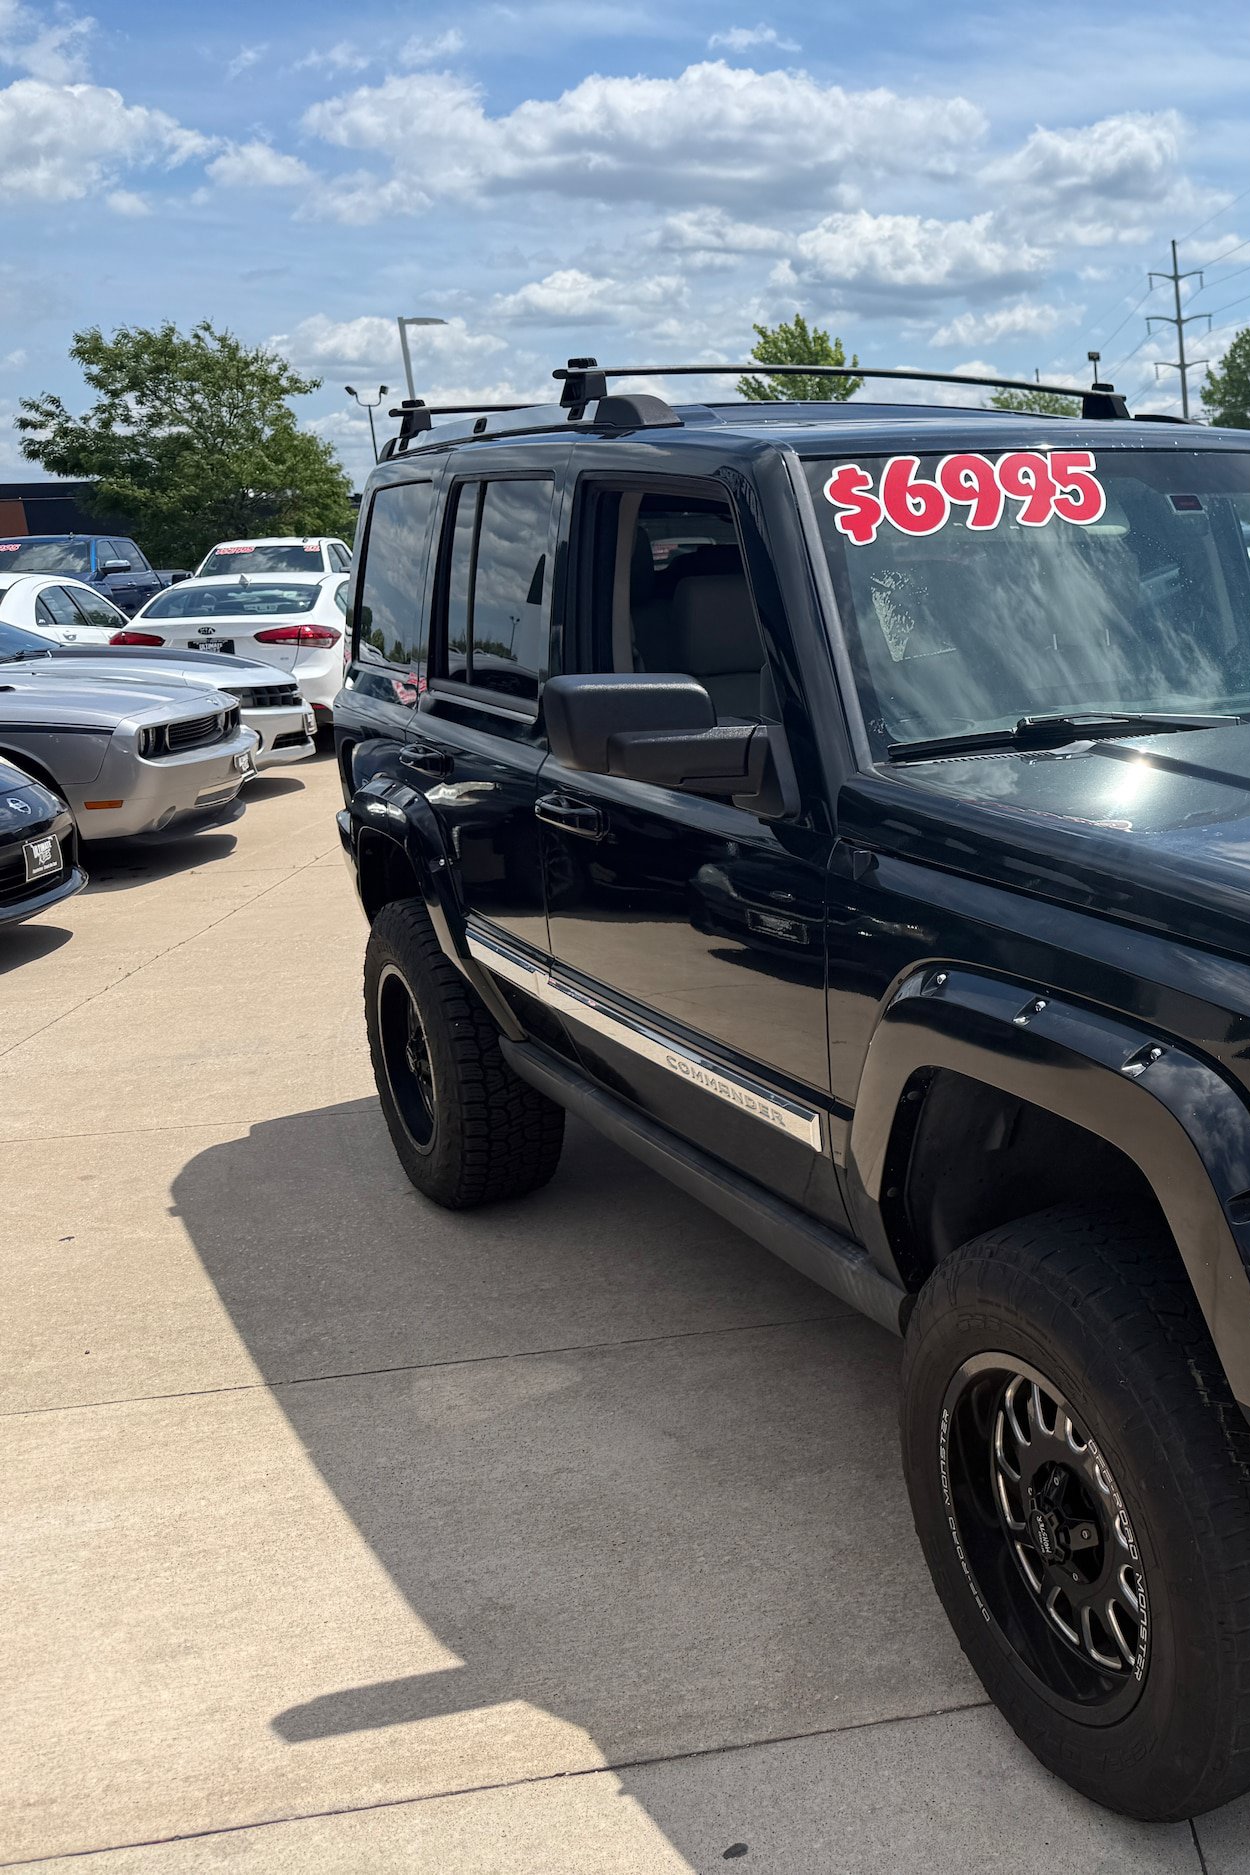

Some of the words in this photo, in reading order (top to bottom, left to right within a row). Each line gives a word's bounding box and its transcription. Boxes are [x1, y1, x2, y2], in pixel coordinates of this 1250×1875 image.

[825, 452, 1105, 545] $6995
[665, 1054, 787, 1127] COMMANDER
[938, 1408, 950, 1506] MONSTER
[1036, 1515, 1052, 1554] MONSTER
[1087, 1438, 1139, 1560] OFF-ROAD
[1133, 1573, 1149, 1682] MONSTER
